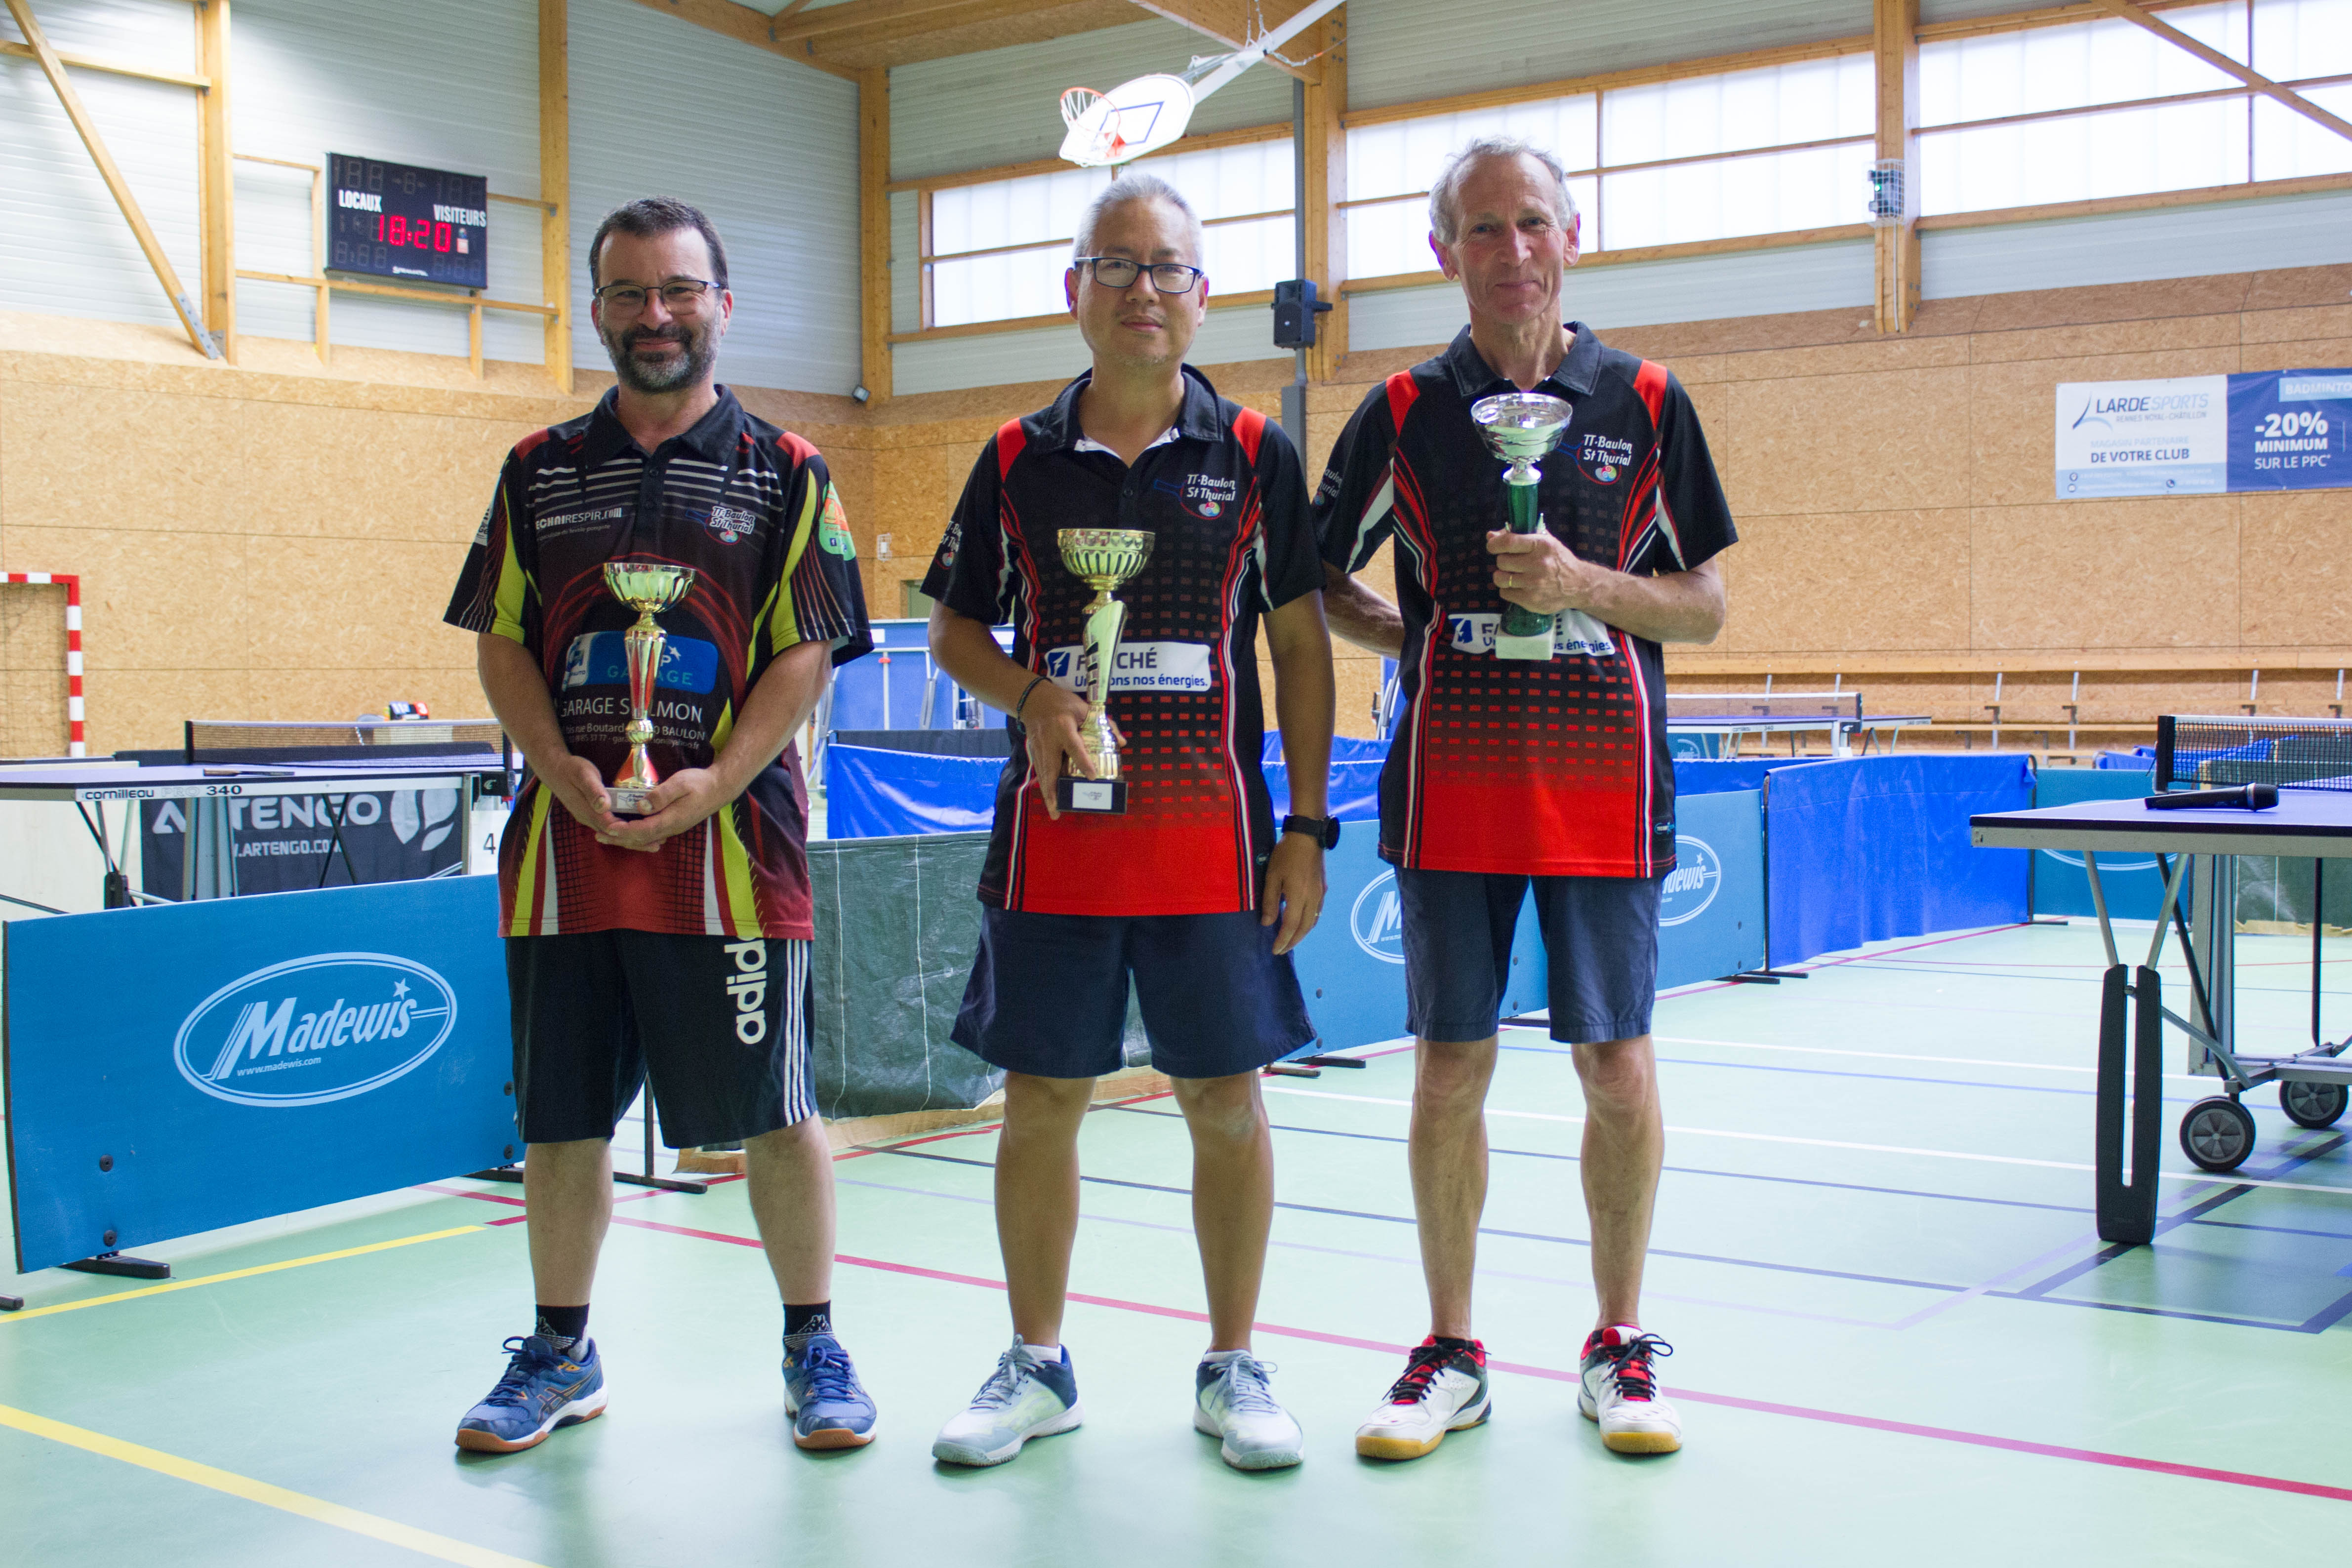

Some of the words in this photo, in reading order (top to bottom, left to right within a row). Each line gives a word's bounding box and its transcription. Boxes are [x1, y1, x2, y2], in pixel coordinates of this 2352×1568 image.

[338, 189, 382, 213] LOCAUX
[433, 203, 487, 228] VISITEURS
[377, 214, 452, 253] 18:20
[2254, 411, 2329, 438] -20%
[2255, 437, 2329, 453] MINIMUM
[1583, 448, 1596, 461] St
[1597, 449, 1632, 466] Thurial
[2091, 452, 2106, 463] DE
[2109, 450, 2152, 462] VOTRE
[2155, 448, 2190, 460] CLUB
[2254, 457, 2281, 470] SUR
[2284, 455, 2299, 469] LE
[1186, 486, 1199, 498] St
[1200, 487, 1236, 502] Thurial
[722, 519, 753, 534] Thurial
[1076, 647, 1157, 671] FCHÉ
[1133, 676, 1155, 685] nos
[1158, 674, 1208, 689] énergies.
[586, 723, 625, 733] Boutard
[662, 726, 705, 741] BAULON
[84, 788, 154, 800] cornilleau
[161, 786, 201, 799] PRO
[206, 785, 243, 796] 340
[152, 793, 382, 835] ATENGO
[483, 833, 496, 855] 4
[724, 938, 767, 1045] adid
[216, 997, 418, 1080] Madewis
[236, 1057, 322, 1077] www.madewis.com
